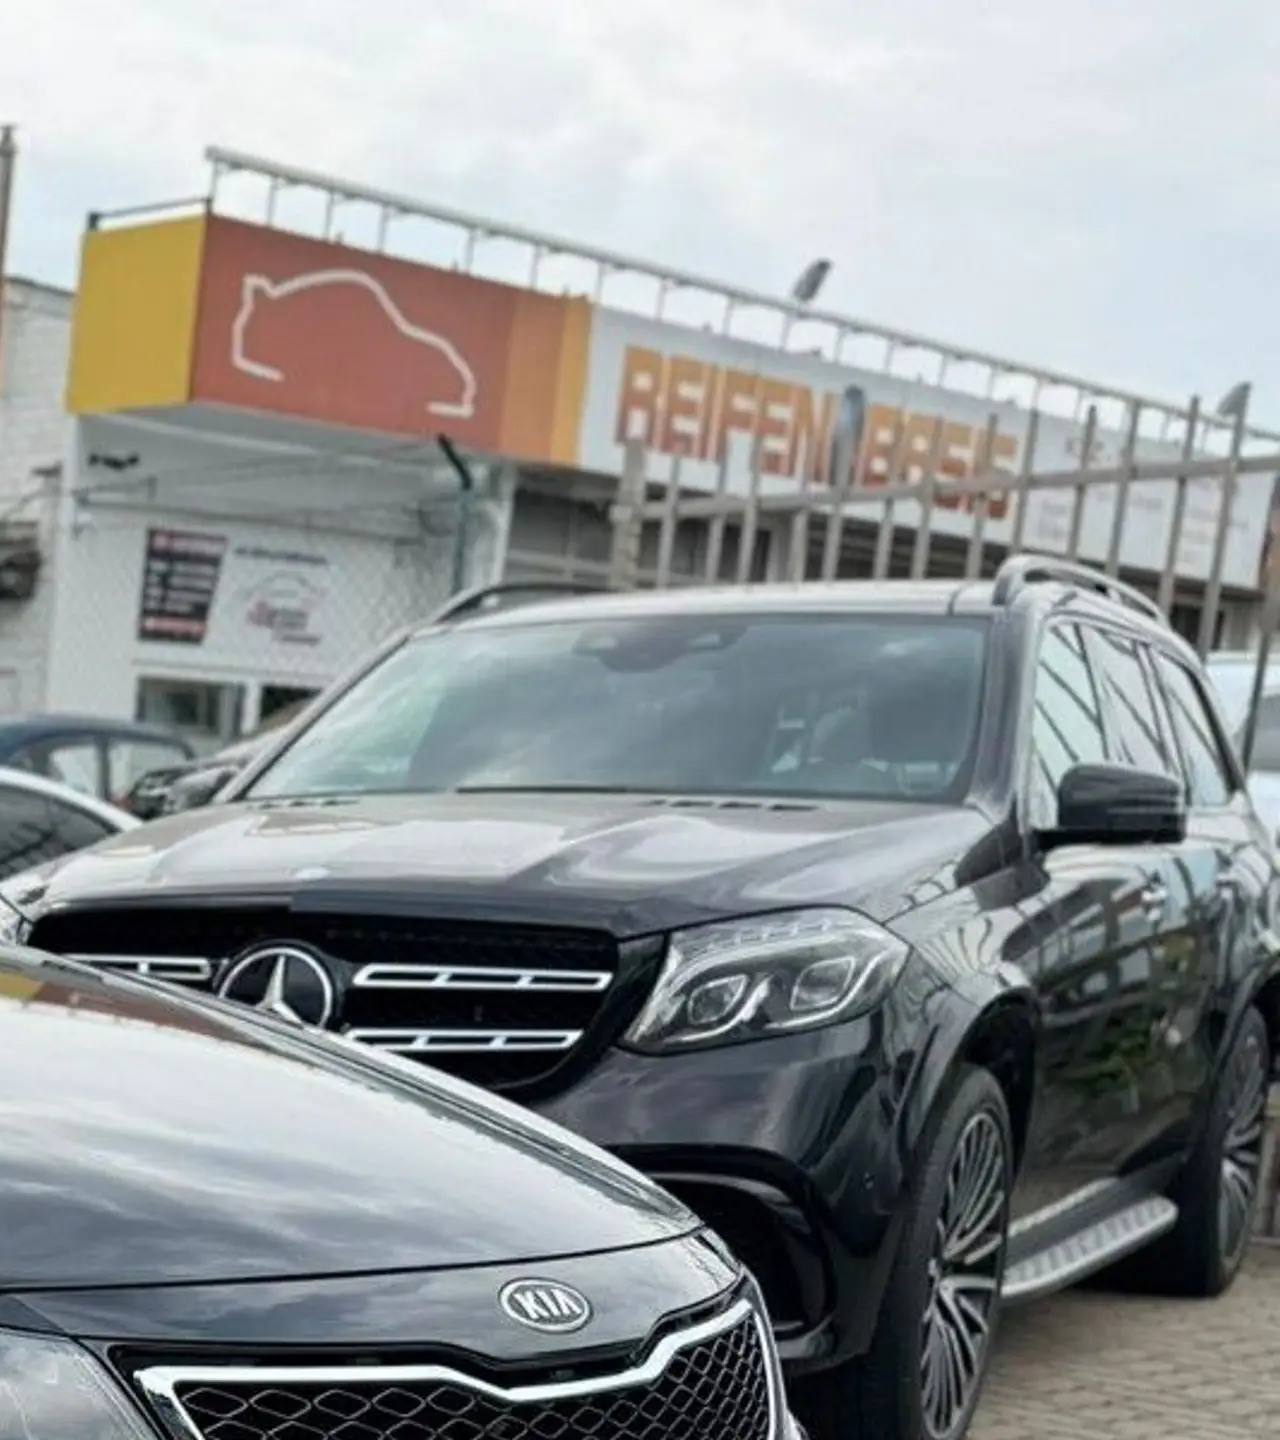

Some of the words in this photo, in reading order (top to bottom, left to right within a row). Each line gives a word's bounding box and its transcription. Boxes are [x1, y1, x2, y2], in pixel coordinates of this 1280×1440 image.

[614, 344, 838, 486] REIFEN
[856, 402, 1019, 521] BASIS
[512, 1288, 582, 1320] KIA
